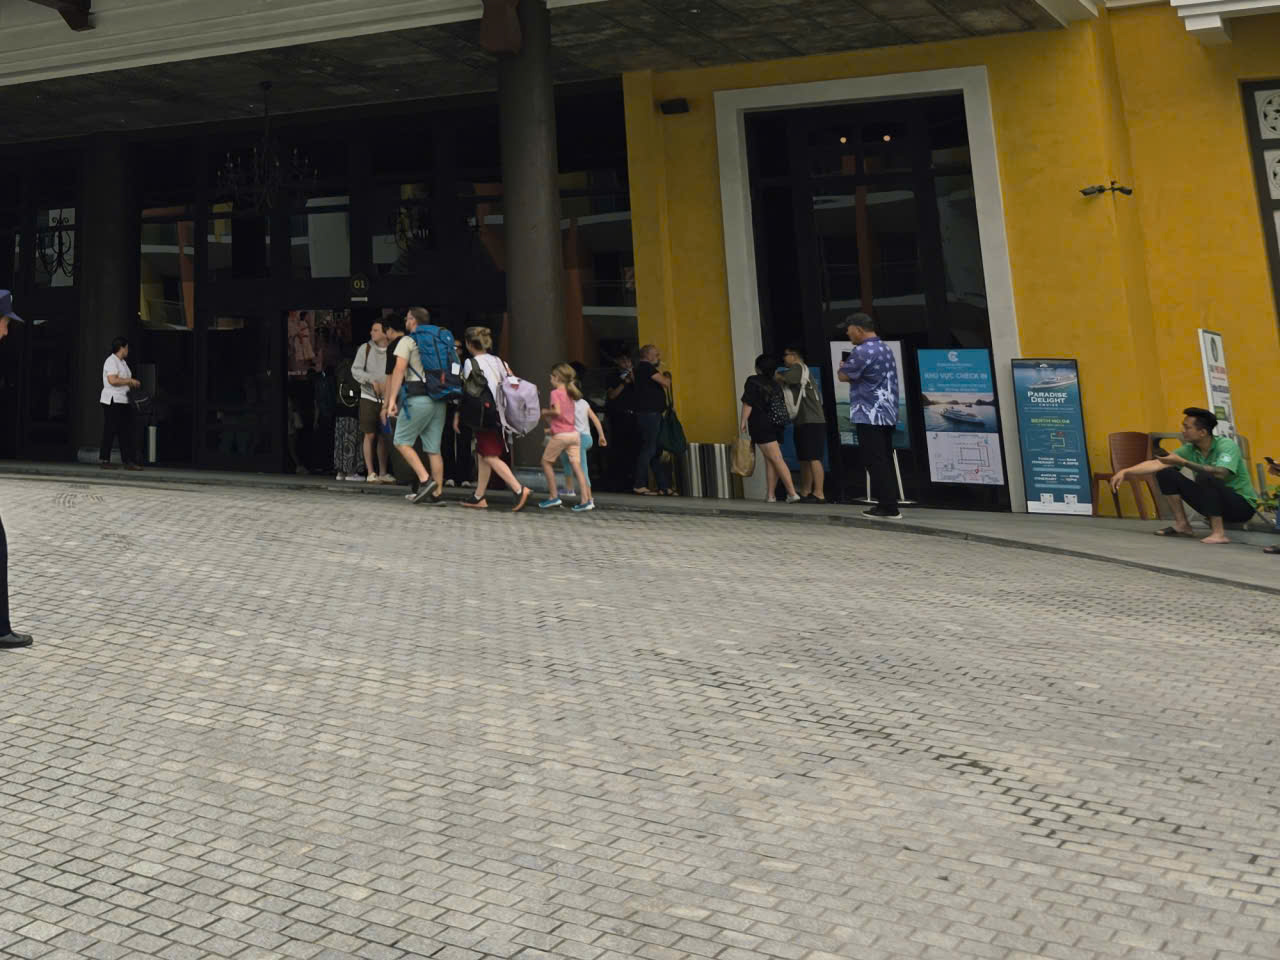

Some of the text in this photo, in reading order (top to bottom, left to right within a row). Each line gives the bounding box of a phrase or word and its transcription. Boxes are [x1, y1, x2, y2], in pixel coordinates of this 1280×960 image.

[353, 279, 366, 289] 01
[1027, 390, 1069, 399] PARADISE
[1030, 396, 1067, 404] DELIGHT
